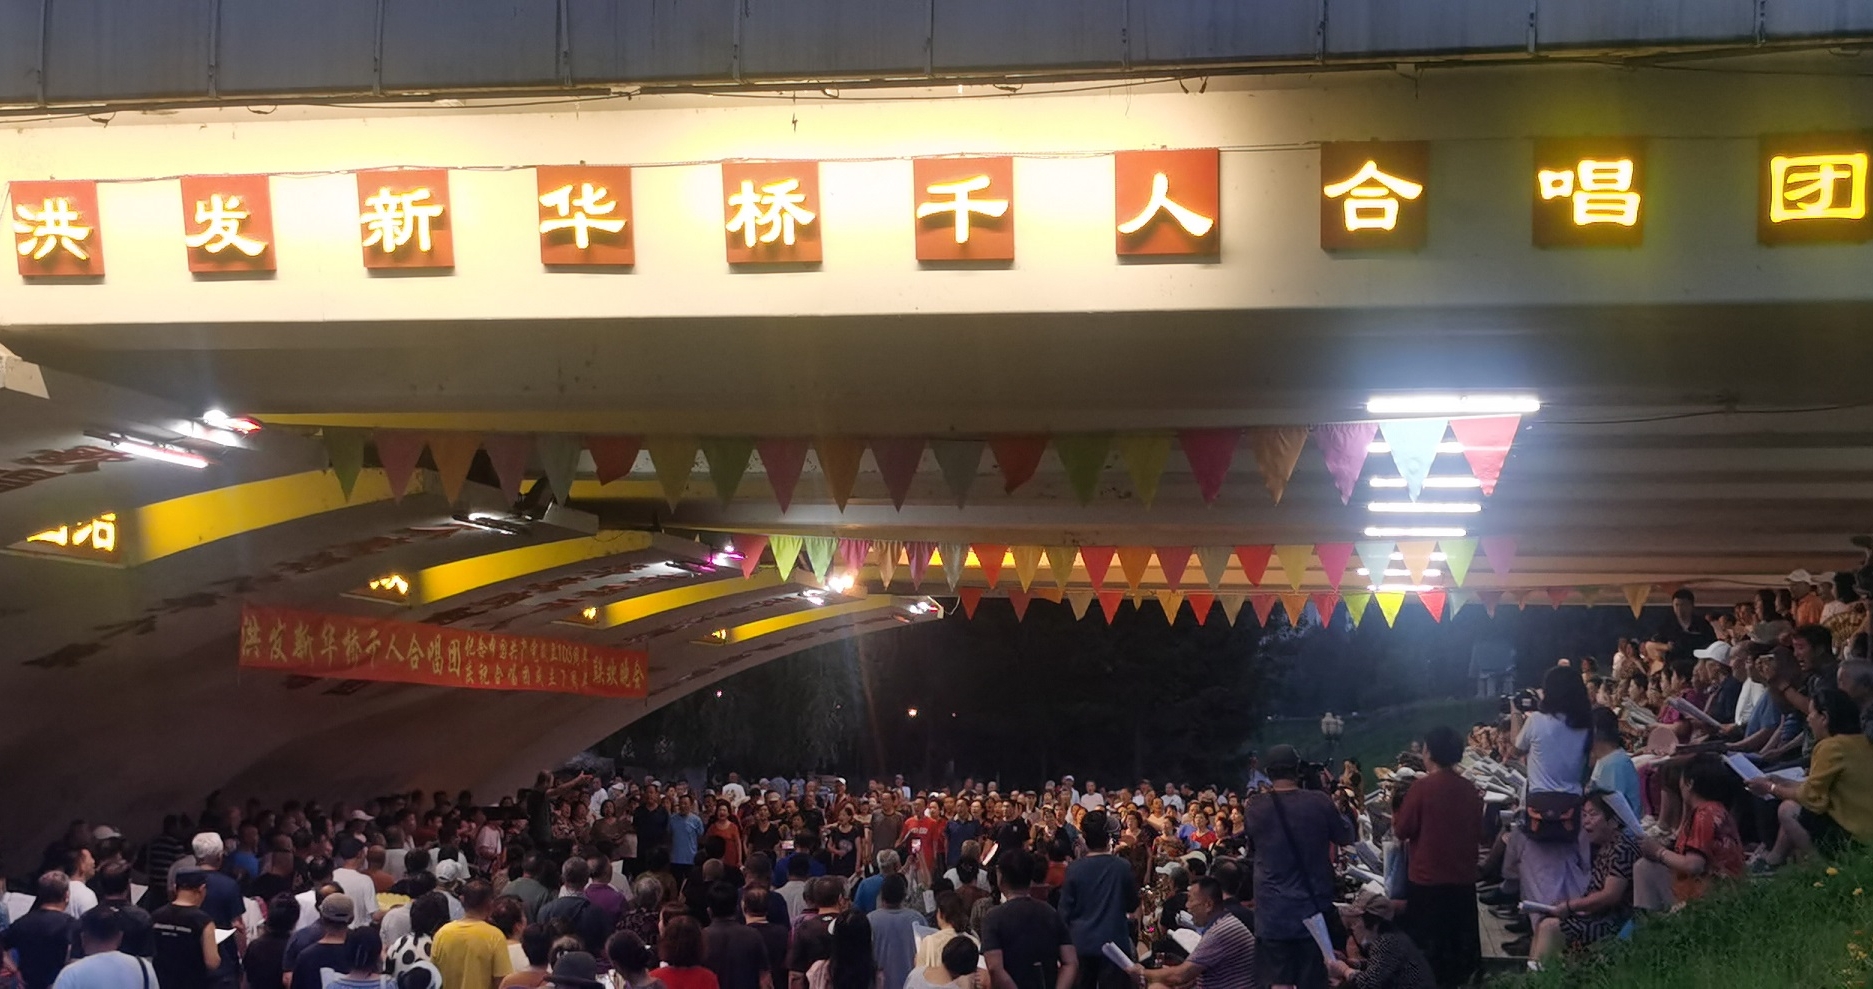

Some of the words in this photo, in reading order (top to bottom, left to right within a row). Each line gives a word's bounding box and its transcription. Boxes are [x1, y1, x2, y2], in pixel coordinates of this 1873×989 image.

[12, 152, 1869, 261] 洪发新华桥千人合唱团
